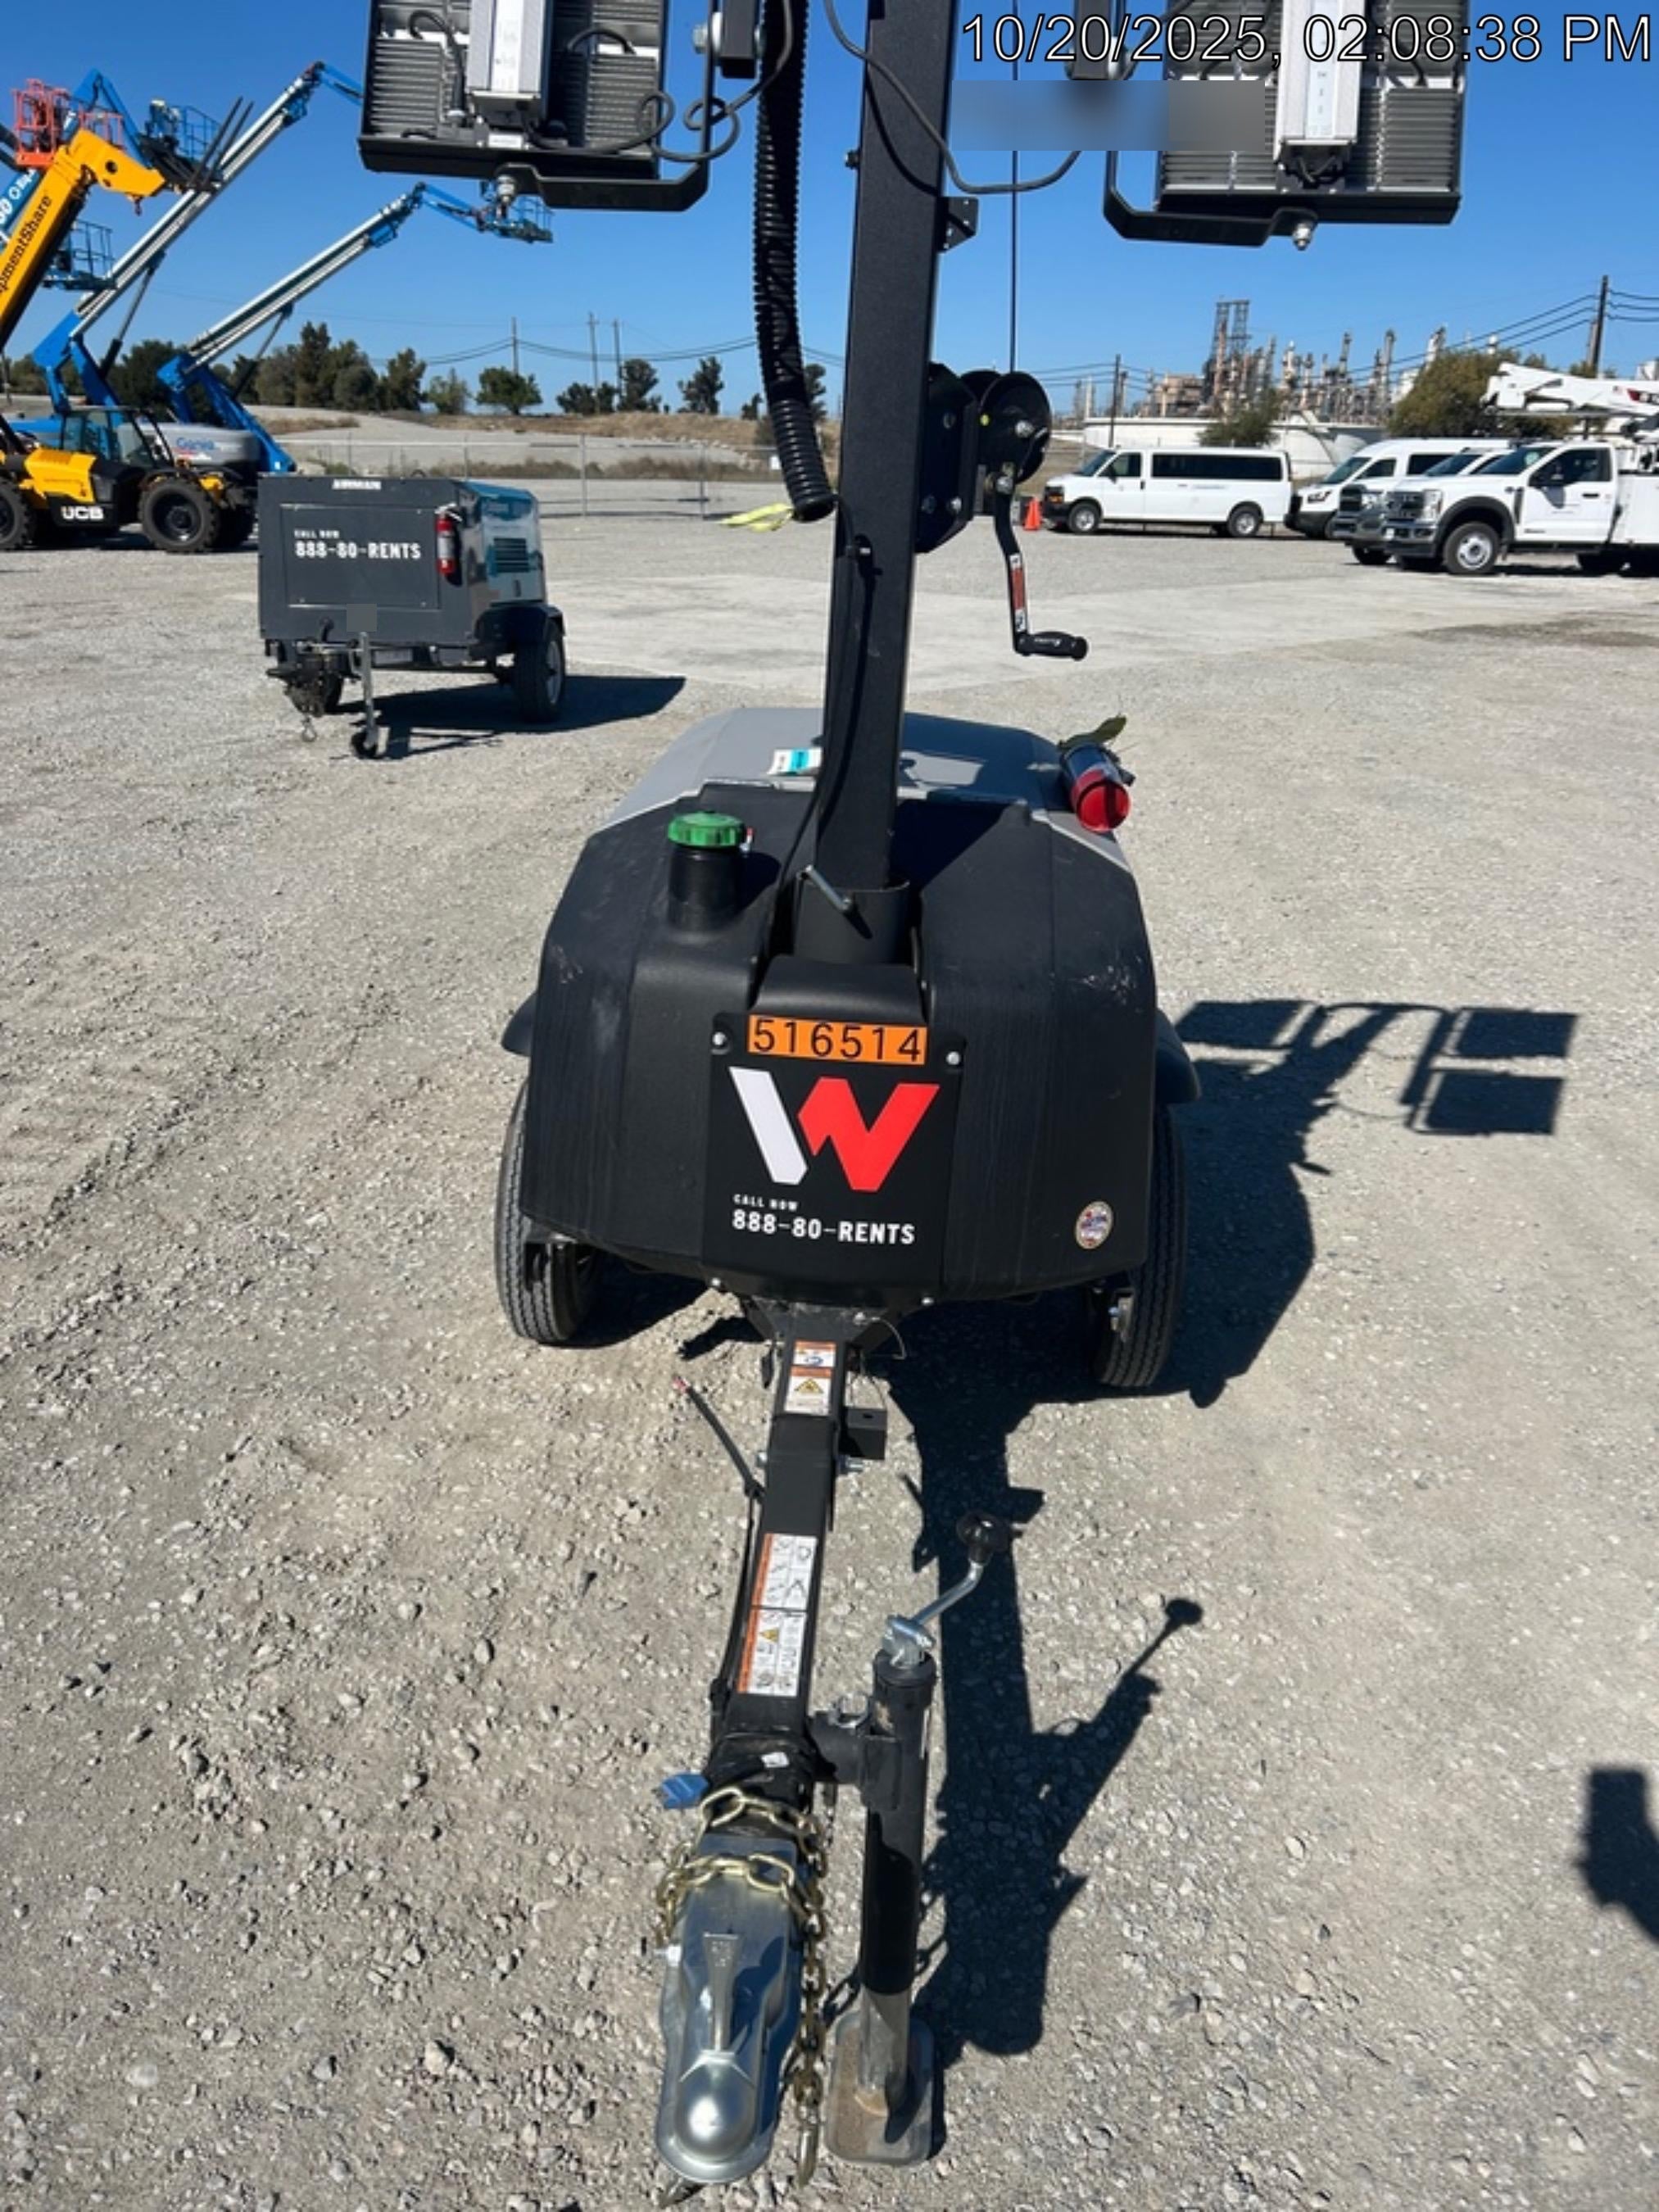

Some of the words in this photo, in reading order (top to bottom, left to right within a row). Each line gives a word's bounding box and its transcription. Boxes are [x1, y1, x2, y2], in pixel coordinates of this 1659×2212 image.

[295, 541, 422, 559] 888-80-RENTS
[753, 1018, 921, 1062] 516514
[732, 1193, 765, 1208] CALL
[768, 1198, 799, 1213] NOW
[732, 1208, 916, 1245] 888-80-RENTS
